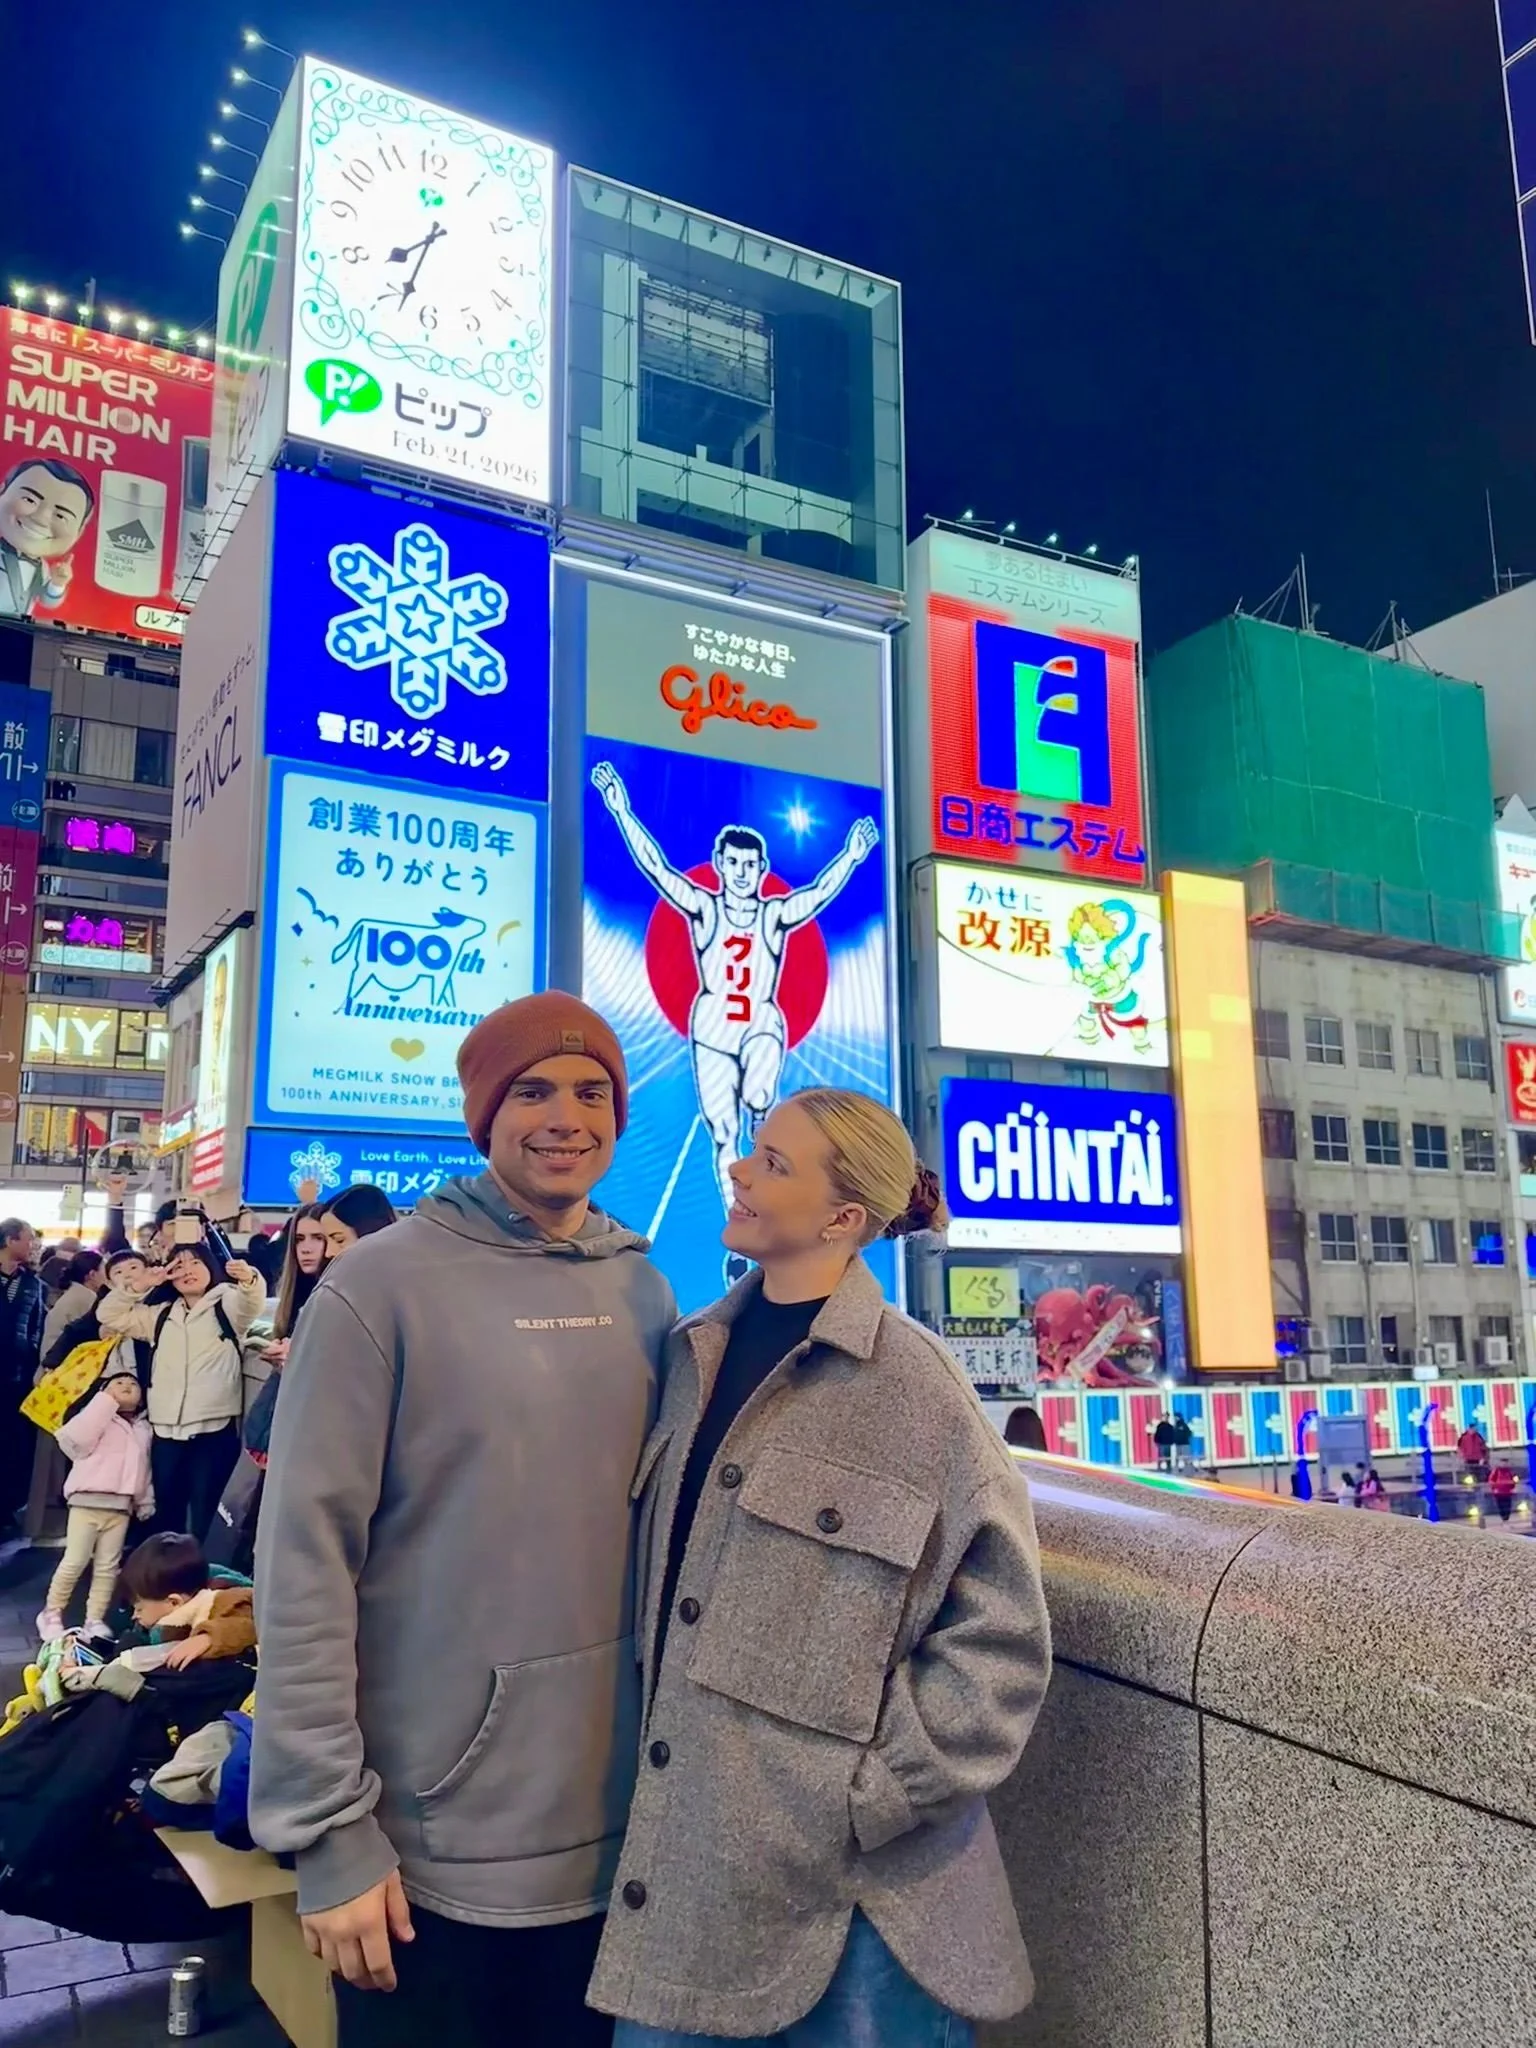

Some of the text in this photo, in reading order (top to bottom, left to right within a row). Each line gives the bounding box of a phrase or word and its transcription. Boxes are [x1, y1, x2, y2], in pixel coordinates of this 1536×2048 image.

[341, 158, 375, 193] 10
[419, 147, 450, 179] 12
[329, 200, 358, 222] 9
[340, 244, 370, 265] 8
[418, 304, 438, 331] 6
[489, 289, 513, 313] 4
[460, 307, 481, 333] 5
[10, 344, 158, 406] SUPER
[325, 363, 369, 407] P!
[6, 379, 170, 444] MILLION
[395, 381, 493, 438] ピップ
[3, 414, 117, 465] HAIR
[480, 455, 538, 486] 2026
[118, 533, 148, 548] SMH
[693, 644, 787, 679] ゆたかな人生
[659, 664, 817, 735] Glico
[317, 711, 511, 772] 雪印メグミルク
[181, 705, 242, 838] FANCL
[307, 797, 515, 857] 創業100周年
[941, 795, 1146, 864] 日商エステム
[336, 846, 489, 897] ありがとう
[966, 880, 1043, 912] かせに
[958, 910, 1052, 958] 改源
[722, 931, 756, 1023] グリコ
[28, 1015, 111, 1057] NY
[281, 1087, 322, 1101] 100th
[313, 1067, 459, 1088] MEGMILK SNOW BR
[361, 1150, 390, 1161] Love
[394, 1150, 433, 1163] Earth.
[438, 1152, 466, 1165] Love
[350, 1167, 450, 1194] 雪印メグ
[514, 1318, 555, 1329] SILENT
[556, 1316, 596, 1328] THEORY
